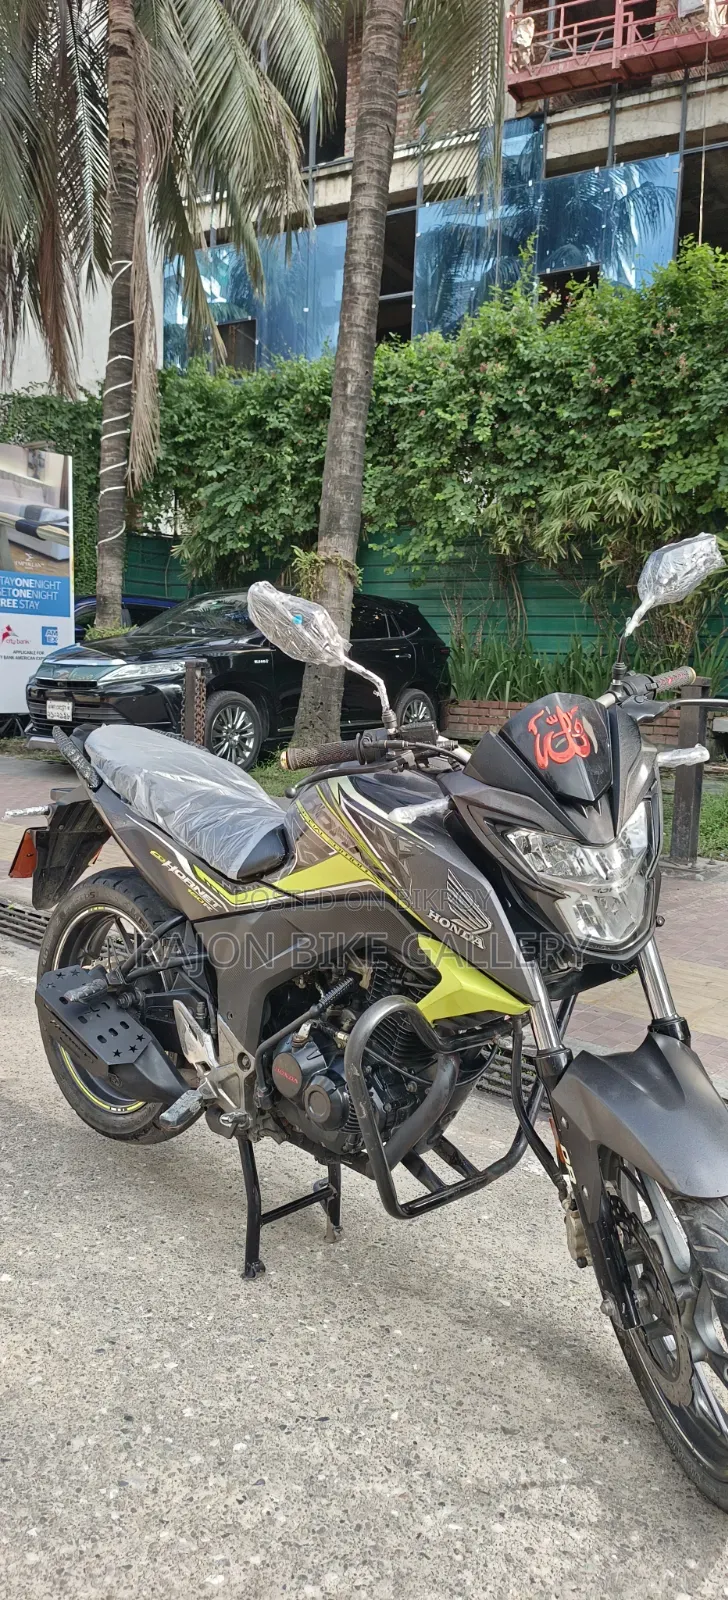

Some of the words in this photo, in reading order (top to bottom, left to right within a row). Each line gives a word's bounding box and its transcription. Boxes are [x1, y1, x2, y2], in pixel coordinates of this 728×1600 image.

[0, 598, 18, 608] REE
[19, 600, 40, 610] STAY
[161, 860, 222, 912] HORNET
[426, 909, 486, 950] HONDA
[273, 1066, 298, 1084] HONDA
